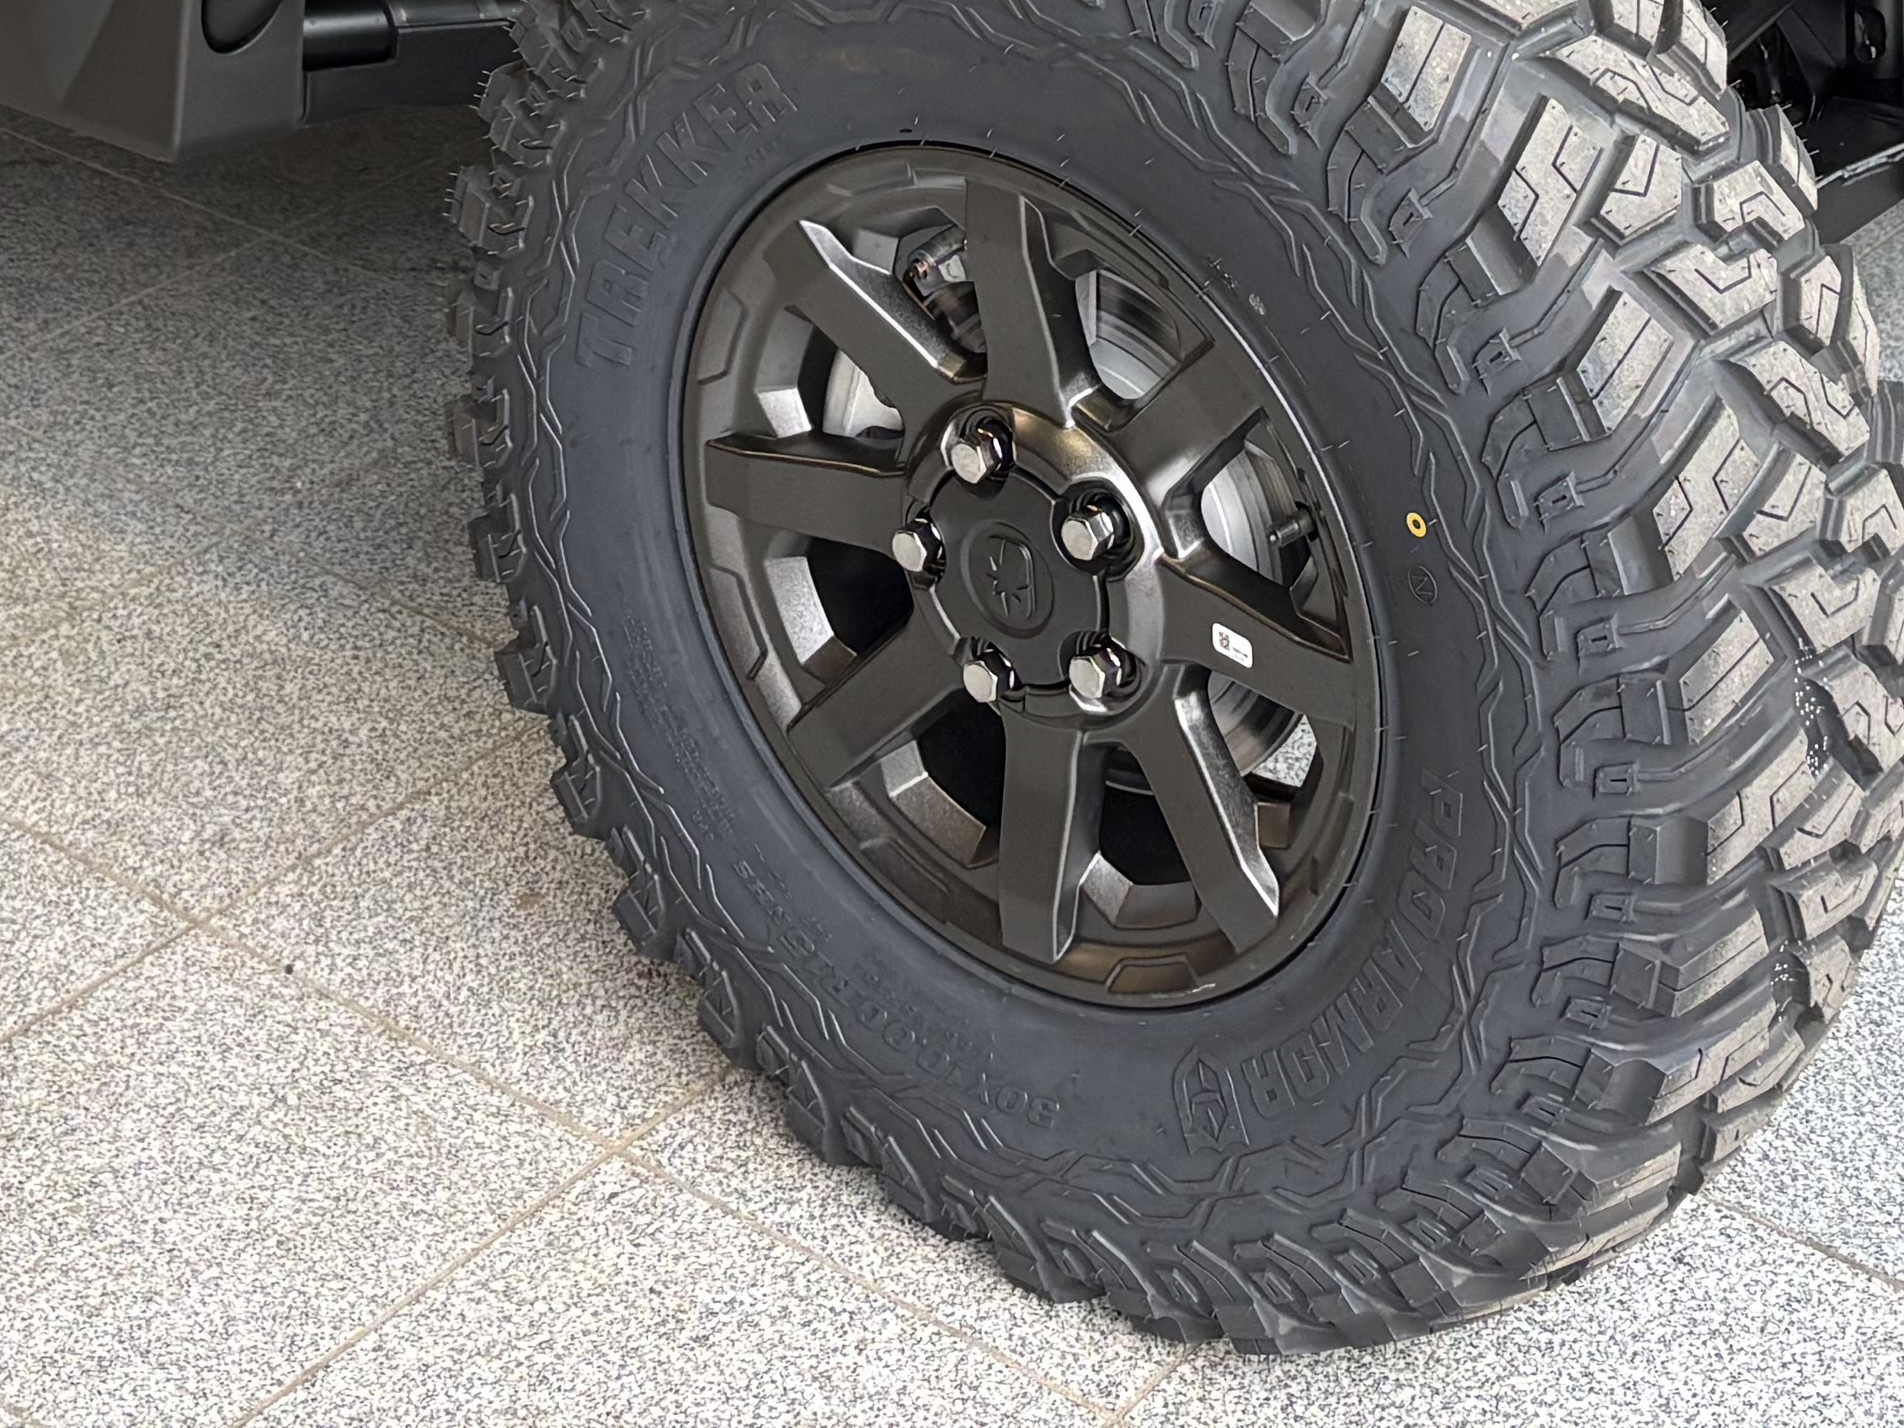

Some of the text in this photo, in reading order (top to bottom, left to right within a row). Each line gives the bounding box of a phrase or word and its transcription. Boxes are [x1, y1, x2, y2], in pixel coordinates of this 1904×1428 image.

[575, 61, 798, 368] TREKKER
[1240, 768, 1464, 1120] PRO ARMOR
